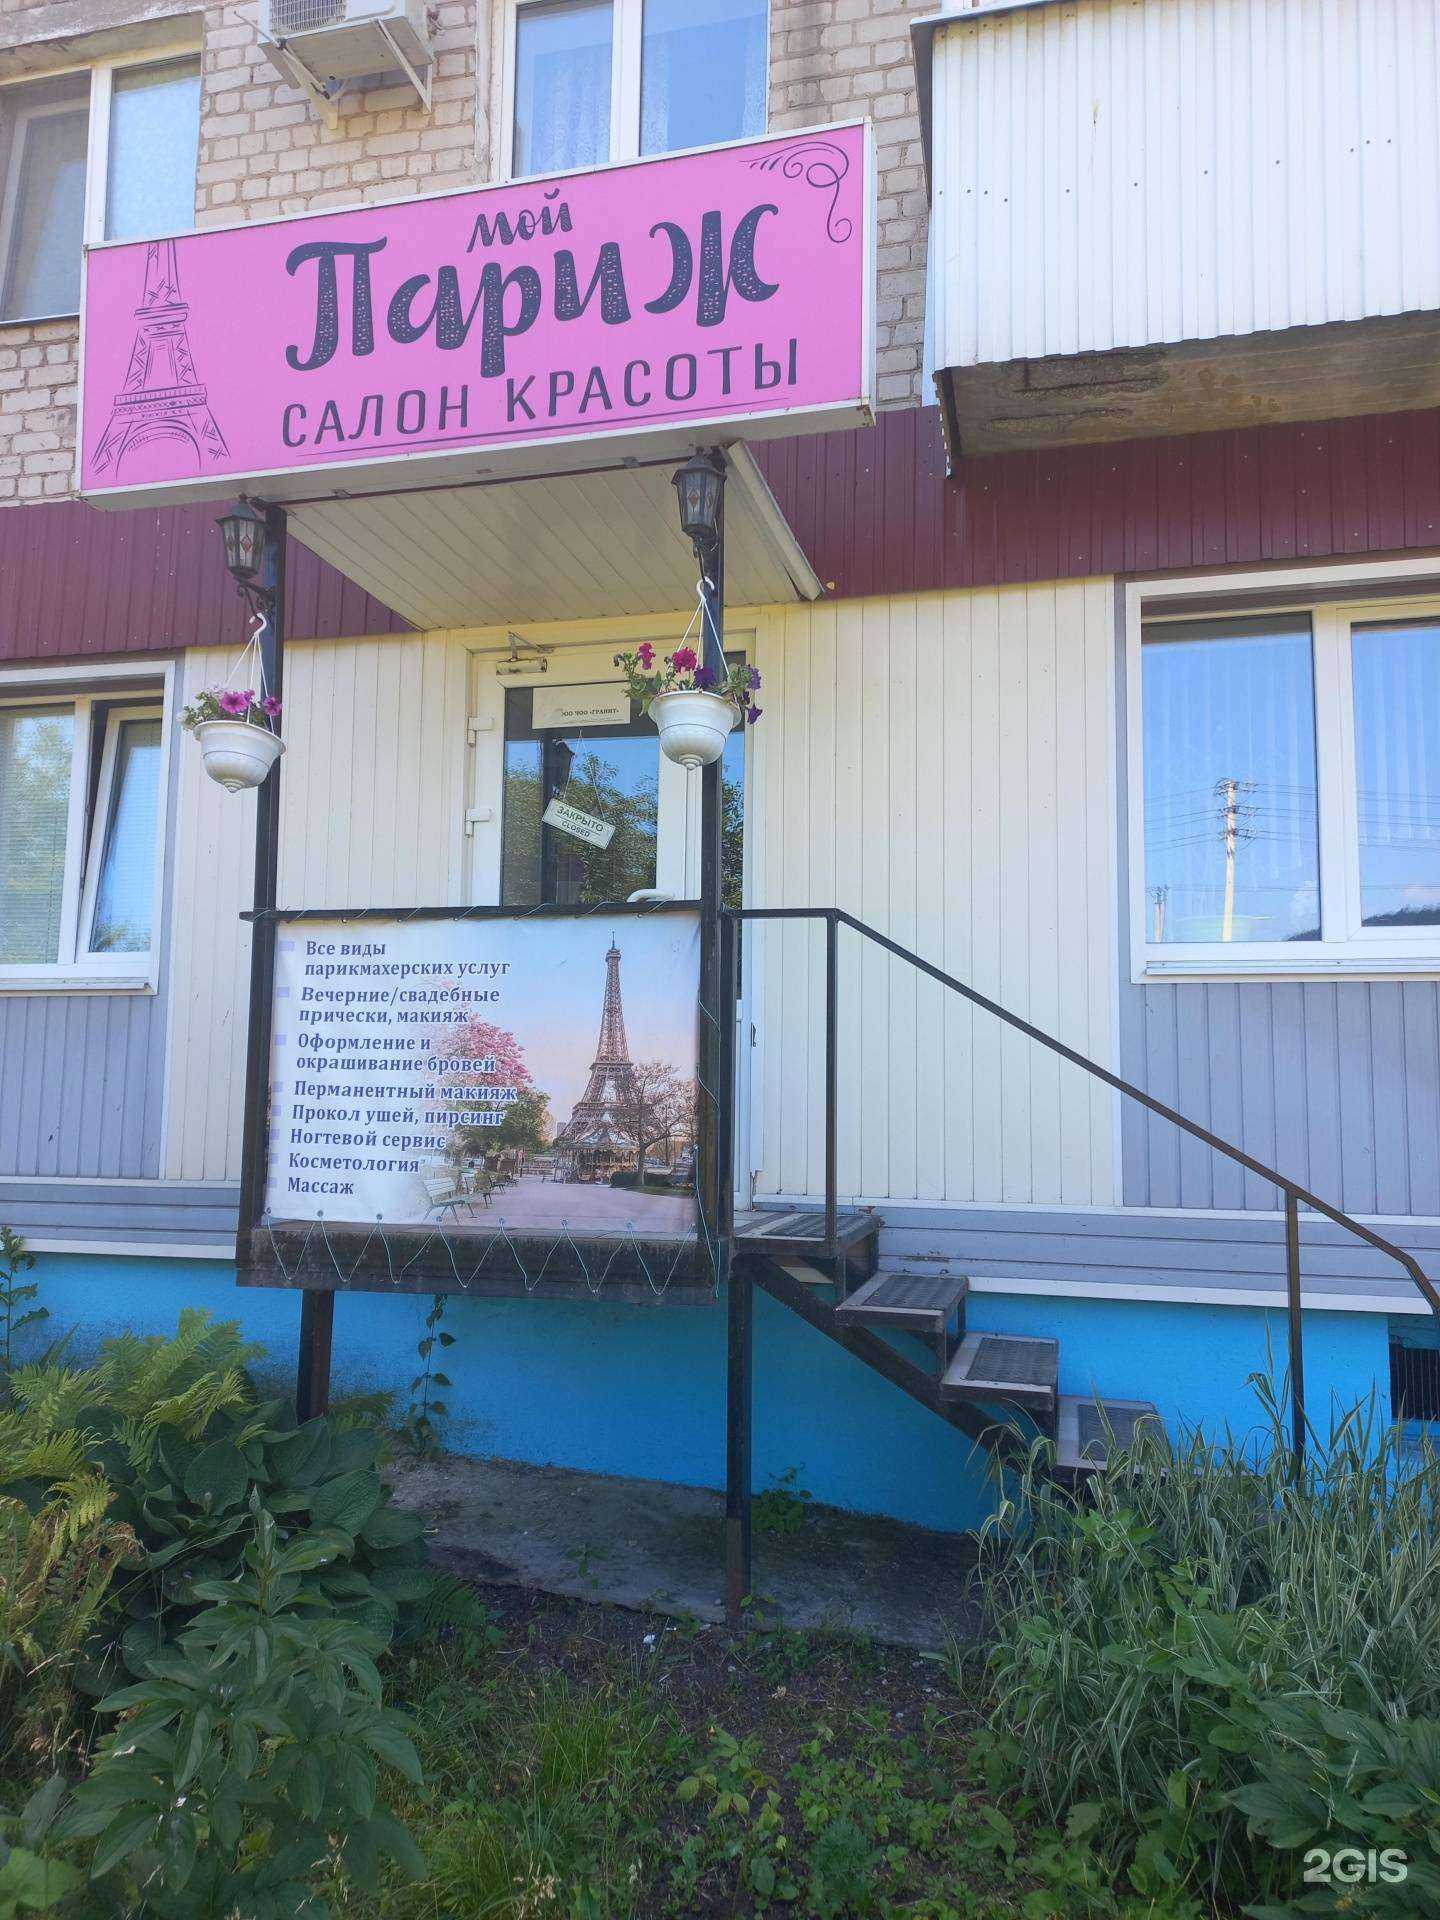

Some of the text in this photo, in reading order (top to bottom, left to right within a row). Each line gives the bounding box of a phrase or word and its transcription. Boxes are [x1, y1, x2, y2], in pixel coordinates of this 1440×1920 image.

[285, 203, 780, 378] Париж
[282, 338, 798, 448] САЛОН КРАСОТЫ
[556, 806, 604, 832] ЗАКРЫТО
[561, 820, 590, 838] CLOSED
[306, 941, 386, 957] Все виды
[305, 962, 510, 978] парикмахерских услуг
[302, 987, 500, 1006] Вечерние/свадебные
[299, 1010, 468, 1025] прически, макияж
[299, 1033, 430, 1053] Оформление и
[297, 1057, 495, 1075] окрашивание бровей
[295, 1081, 517, 1100] Перманентный макияж
[292, 1104, 504, 1127] Прокол ушей, пирсинг
[290, 1129, 446, 1151] Ногтевой сервис
[289, 1153, 419, 1172] Косметология
[288, 1177, 354, 1195] Массаж
